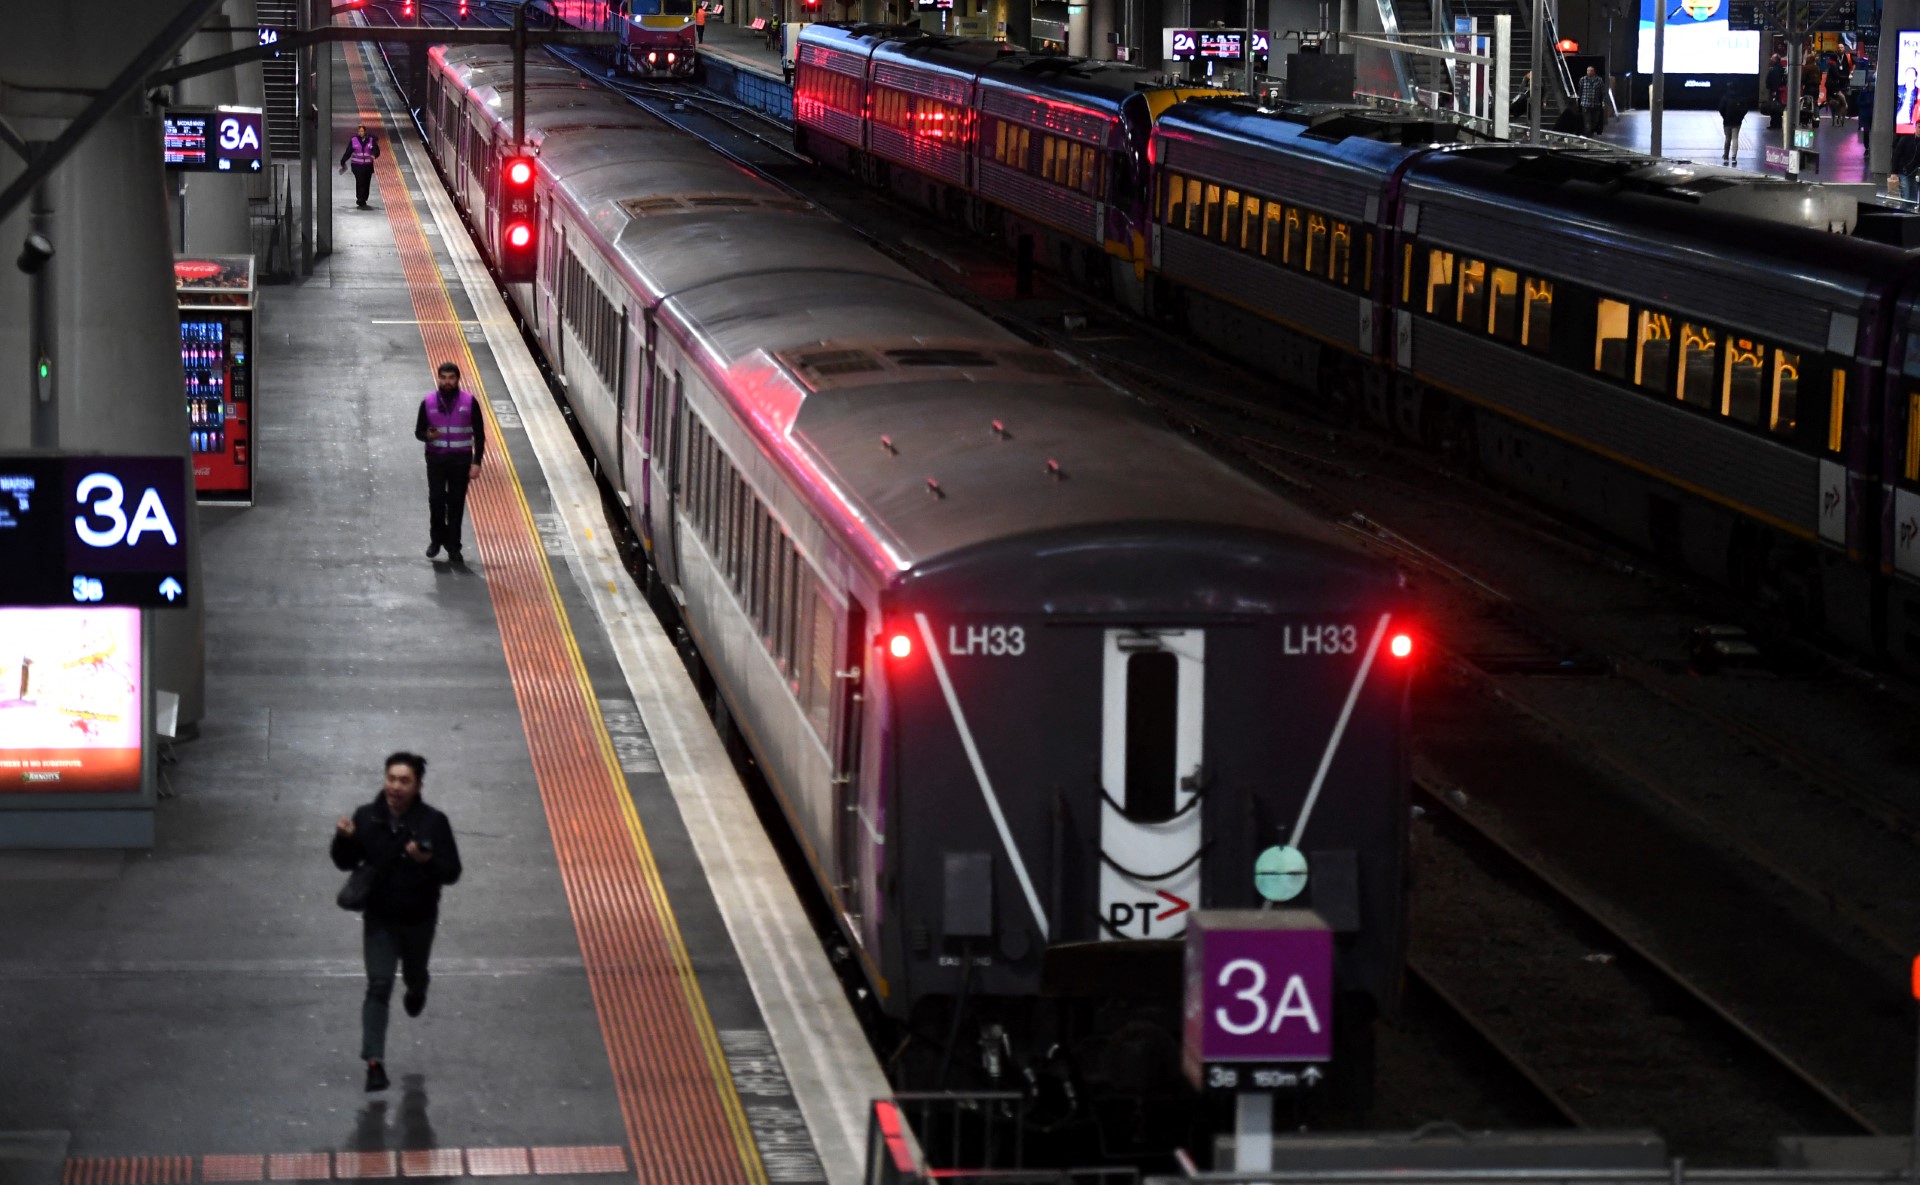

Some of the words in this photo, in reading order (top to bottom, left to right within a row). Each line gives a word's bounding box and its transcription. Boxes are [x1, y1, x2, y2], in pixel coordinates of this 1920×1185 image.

[1173, 33, 1196, 51] 2A
[219, 118, 260, 150] 3A
[74, 472, 178, 548] 3A
[948, 624, 1026, 657] LH33
[1282, 623, 1358, 655] LH33
[1215, 958, 1321, 1036] 3A
